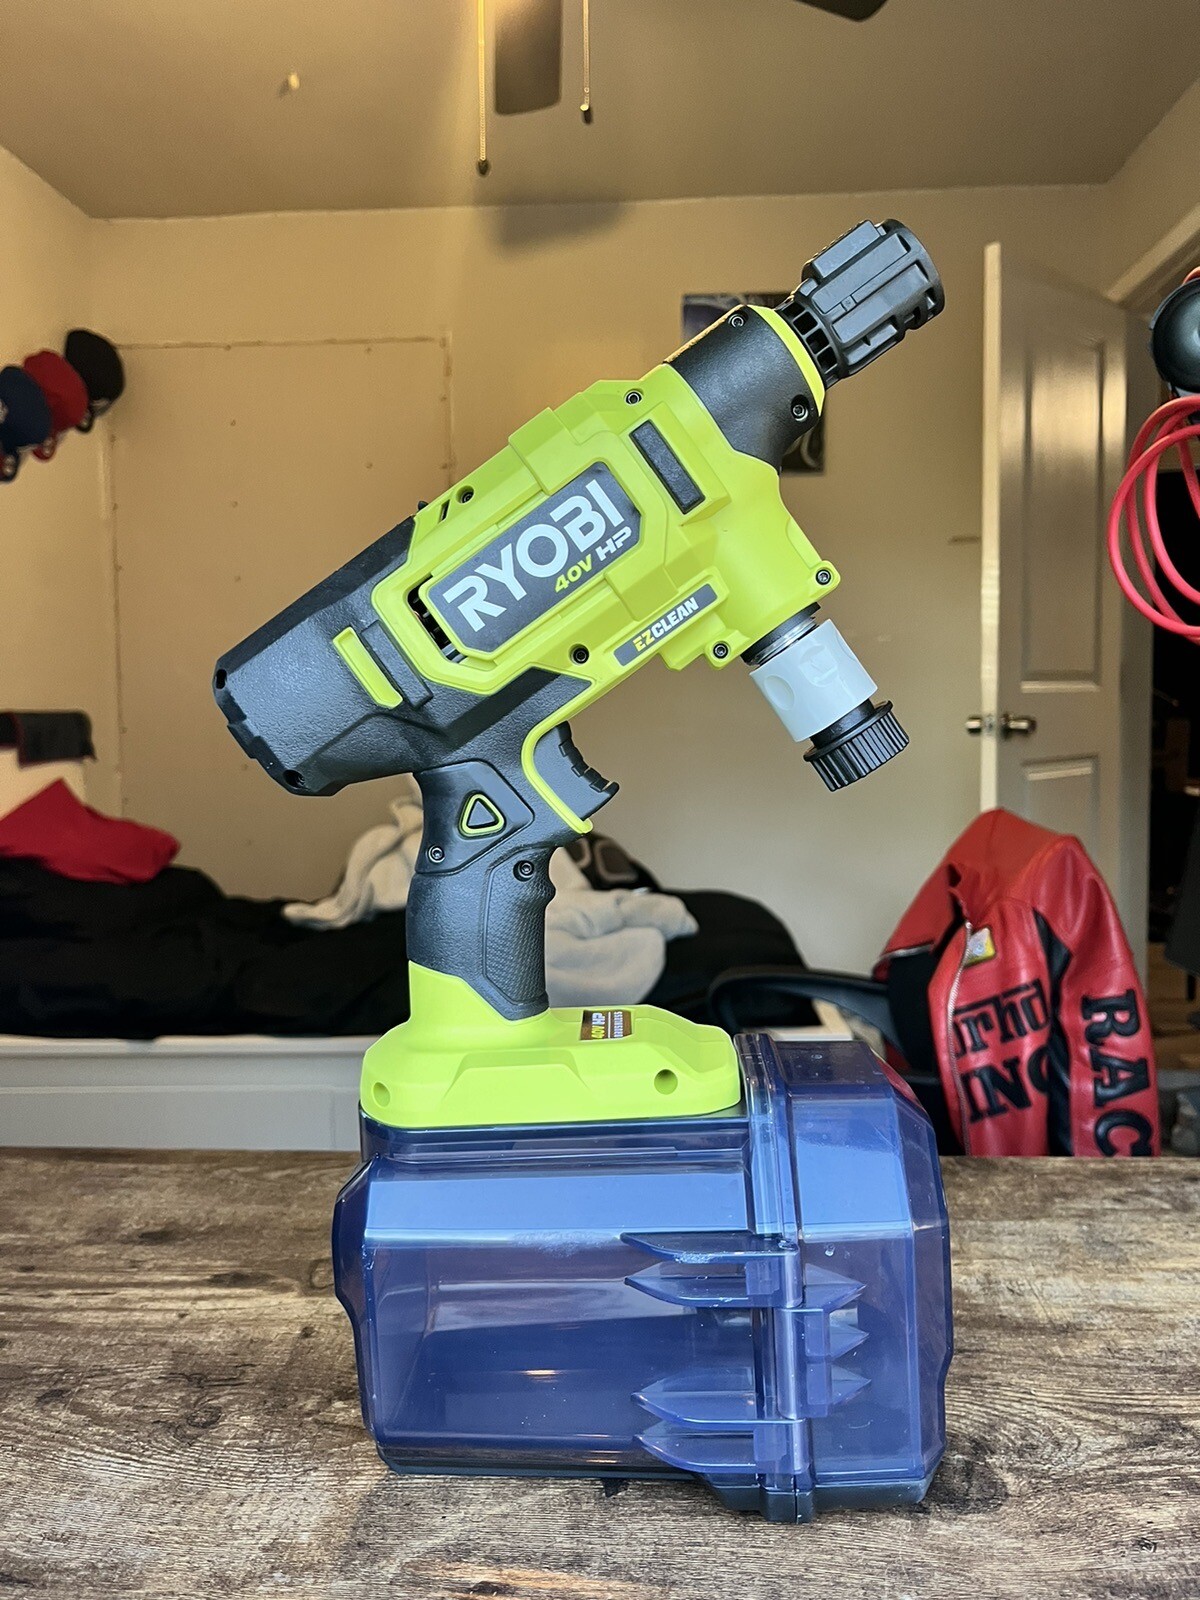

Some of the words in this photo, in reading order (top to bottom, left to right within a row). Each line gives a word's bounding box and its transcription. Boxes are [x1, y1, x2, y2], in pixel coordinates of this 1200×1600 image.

[443, 479, 625, 632] RYOBI
[555, 554, 592, 593] 40V
[595, 526, 632, 561] HP
